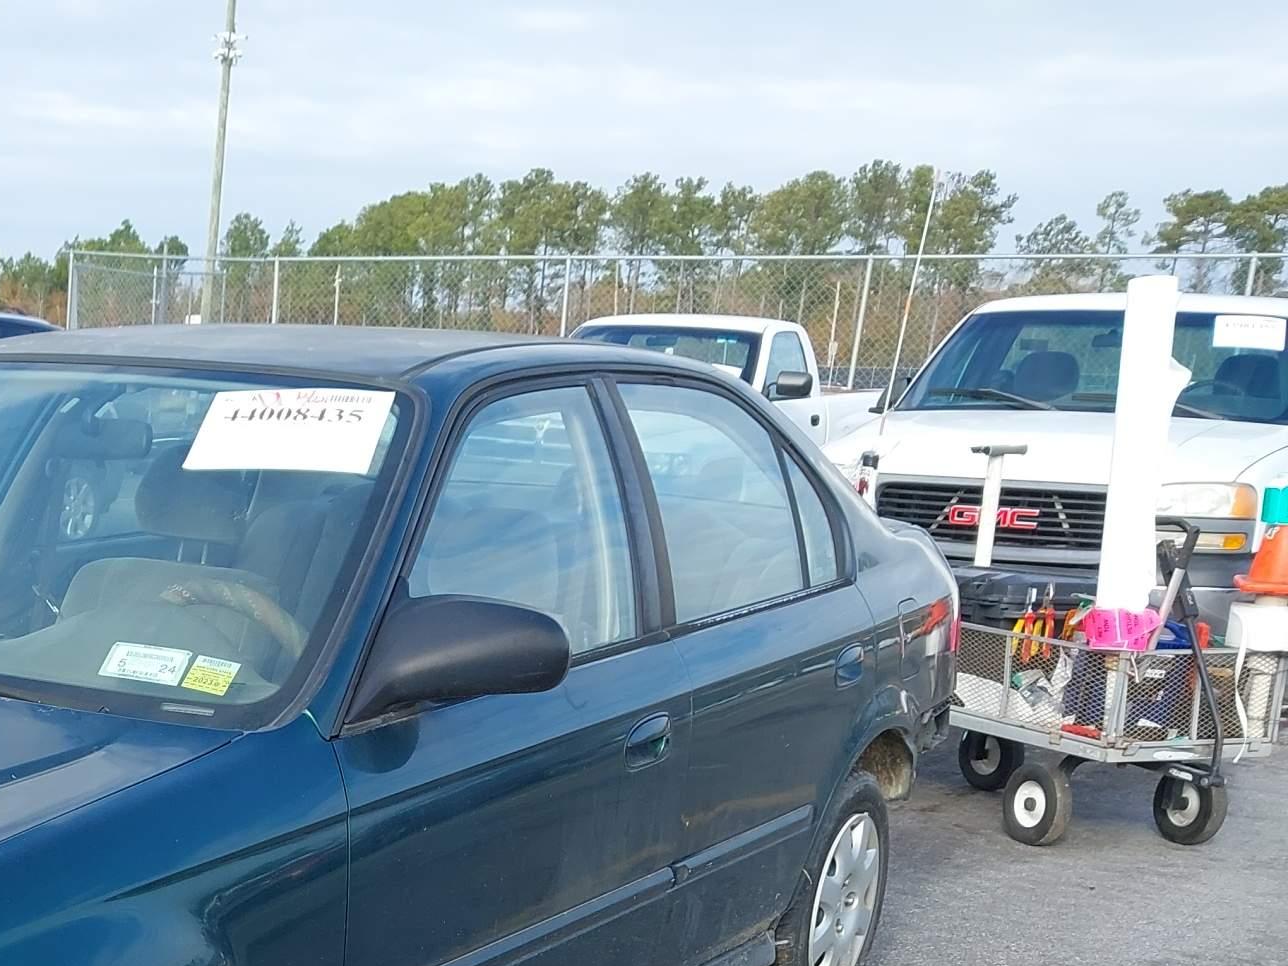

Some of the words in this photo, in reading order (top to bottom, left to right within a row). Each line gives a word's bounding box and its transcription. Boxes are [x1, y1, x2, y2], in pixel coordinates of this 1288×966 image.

[223, 407, 365, 424] 44008435
[117, 657, 128, 668] 5
[158, 663, 177, 675] 24
